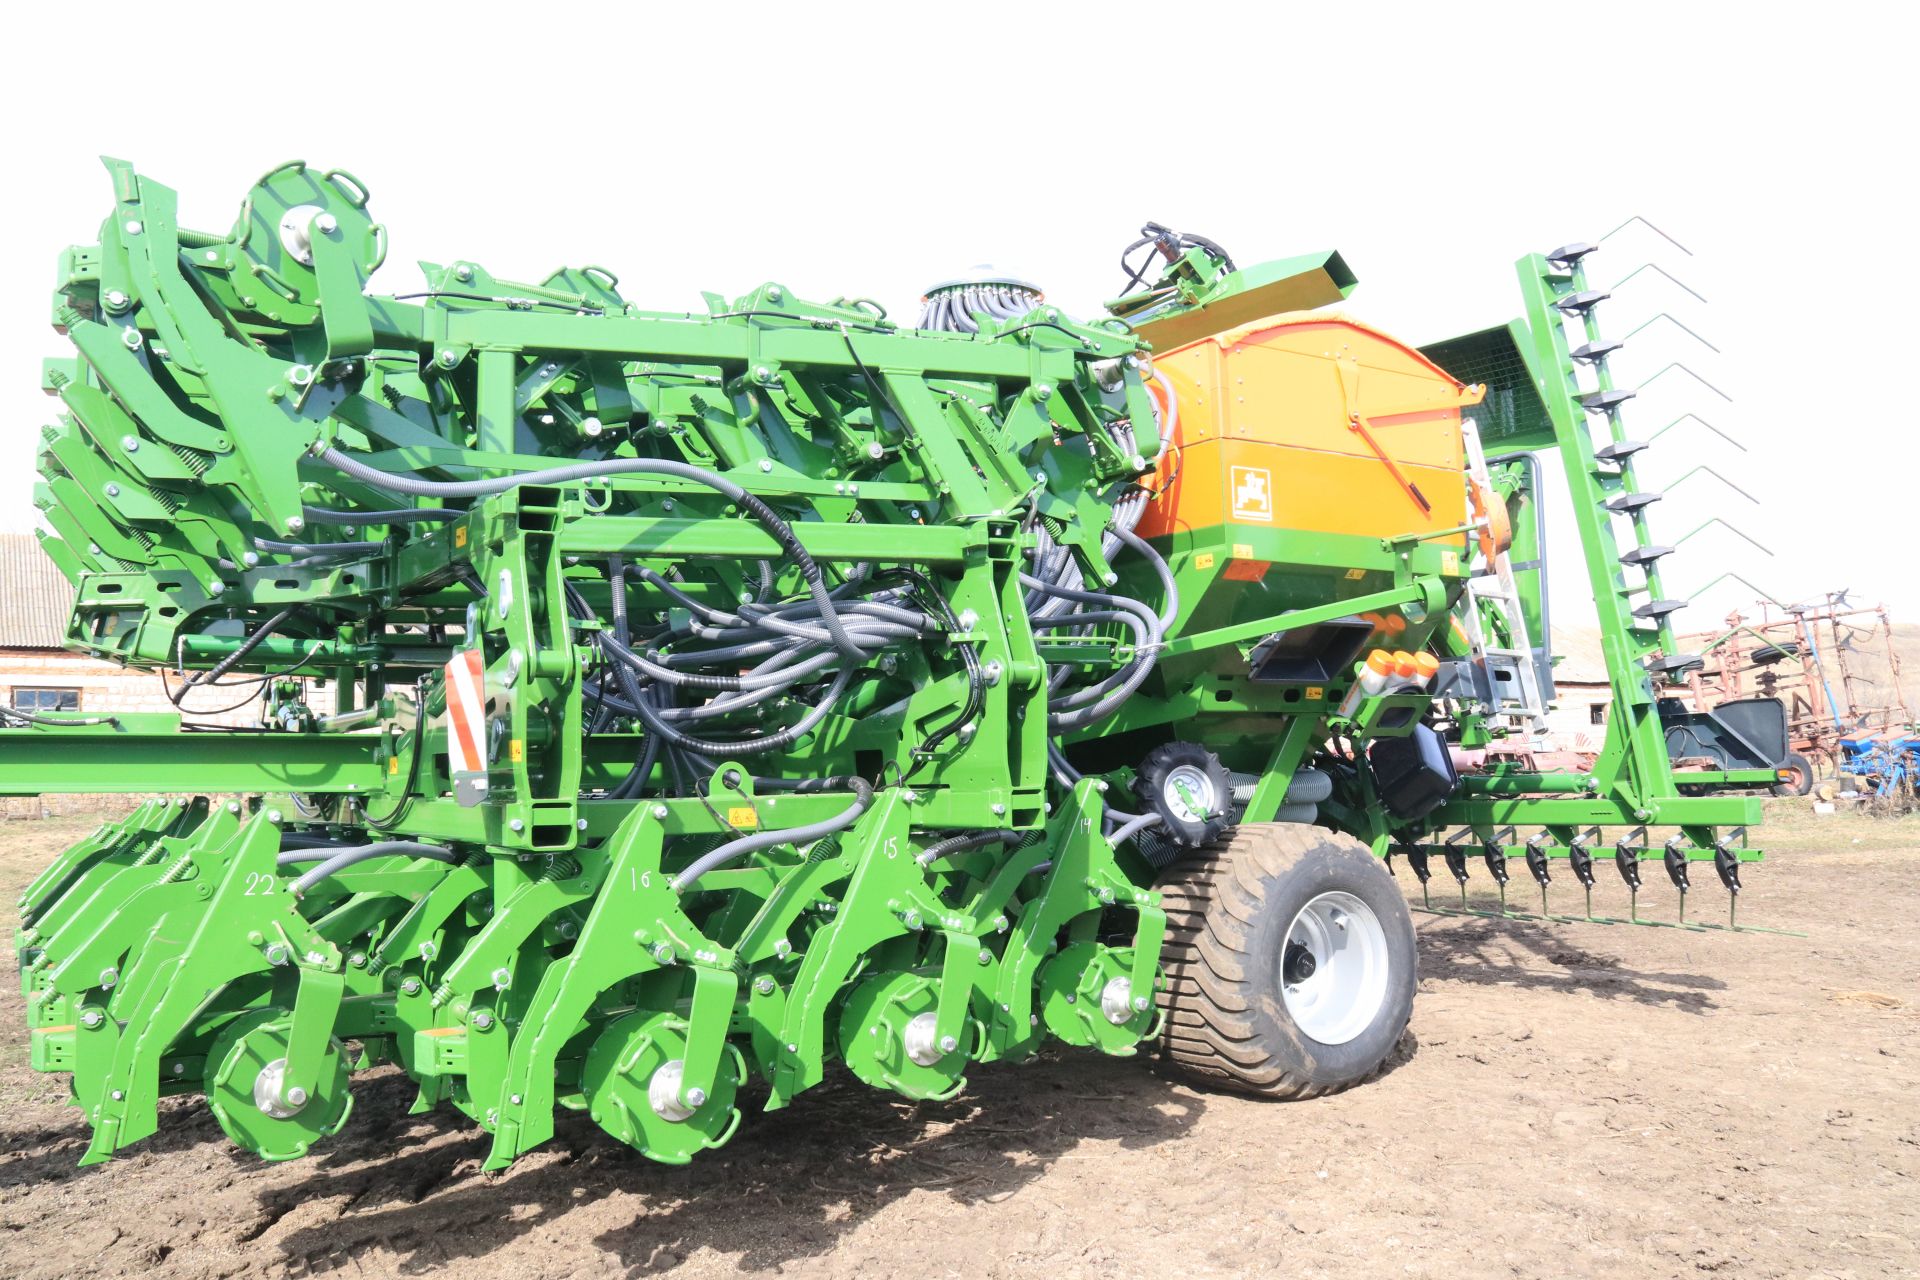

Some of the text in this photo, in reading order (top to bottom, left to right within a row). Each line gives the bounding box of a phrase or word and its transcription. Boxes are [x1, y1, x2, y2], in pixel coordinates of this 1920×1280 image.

[1081, 817, 1092, 835] 14
[884, 836, 898, 859] 15
[243, 871, 275, 896] 22
[631, 867, 652, 892] 16
